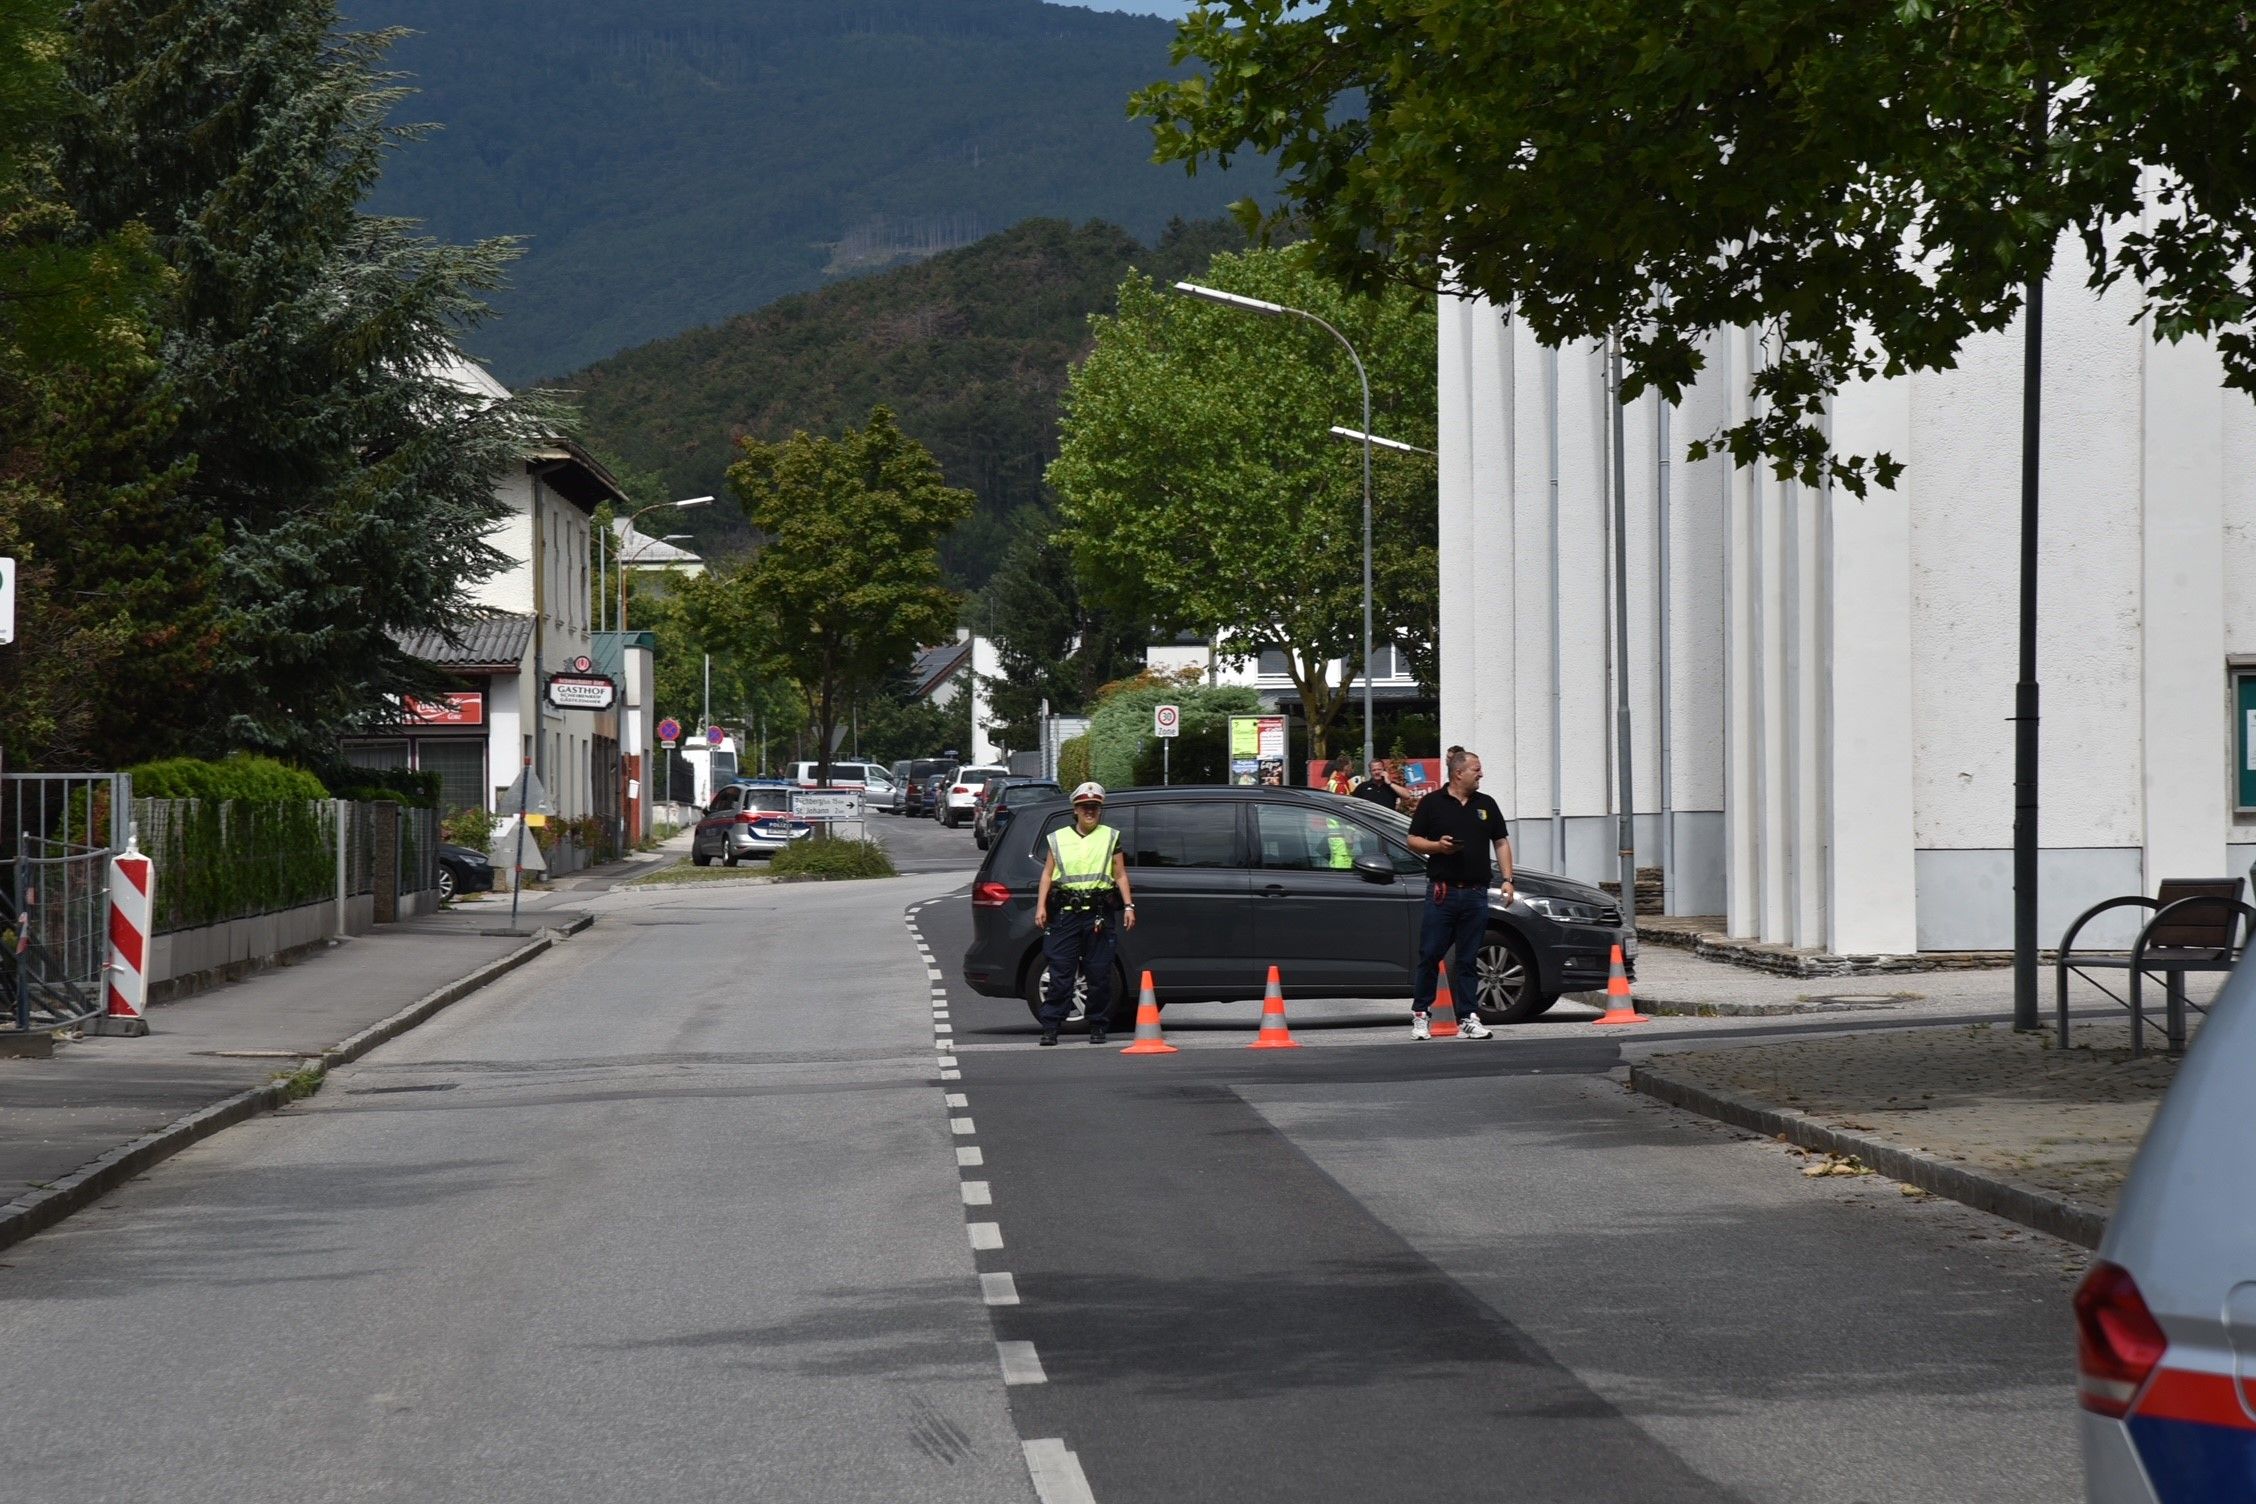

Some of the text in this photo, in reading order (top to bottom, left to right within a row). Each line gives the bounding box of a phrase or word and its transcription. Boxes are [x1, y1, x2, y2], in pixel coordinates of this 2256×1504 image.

[557, 685, 606, 695] GASTHOF
[1162, 712, 1172, 721] 30
[1158, 728, 1176, 736] Zone
